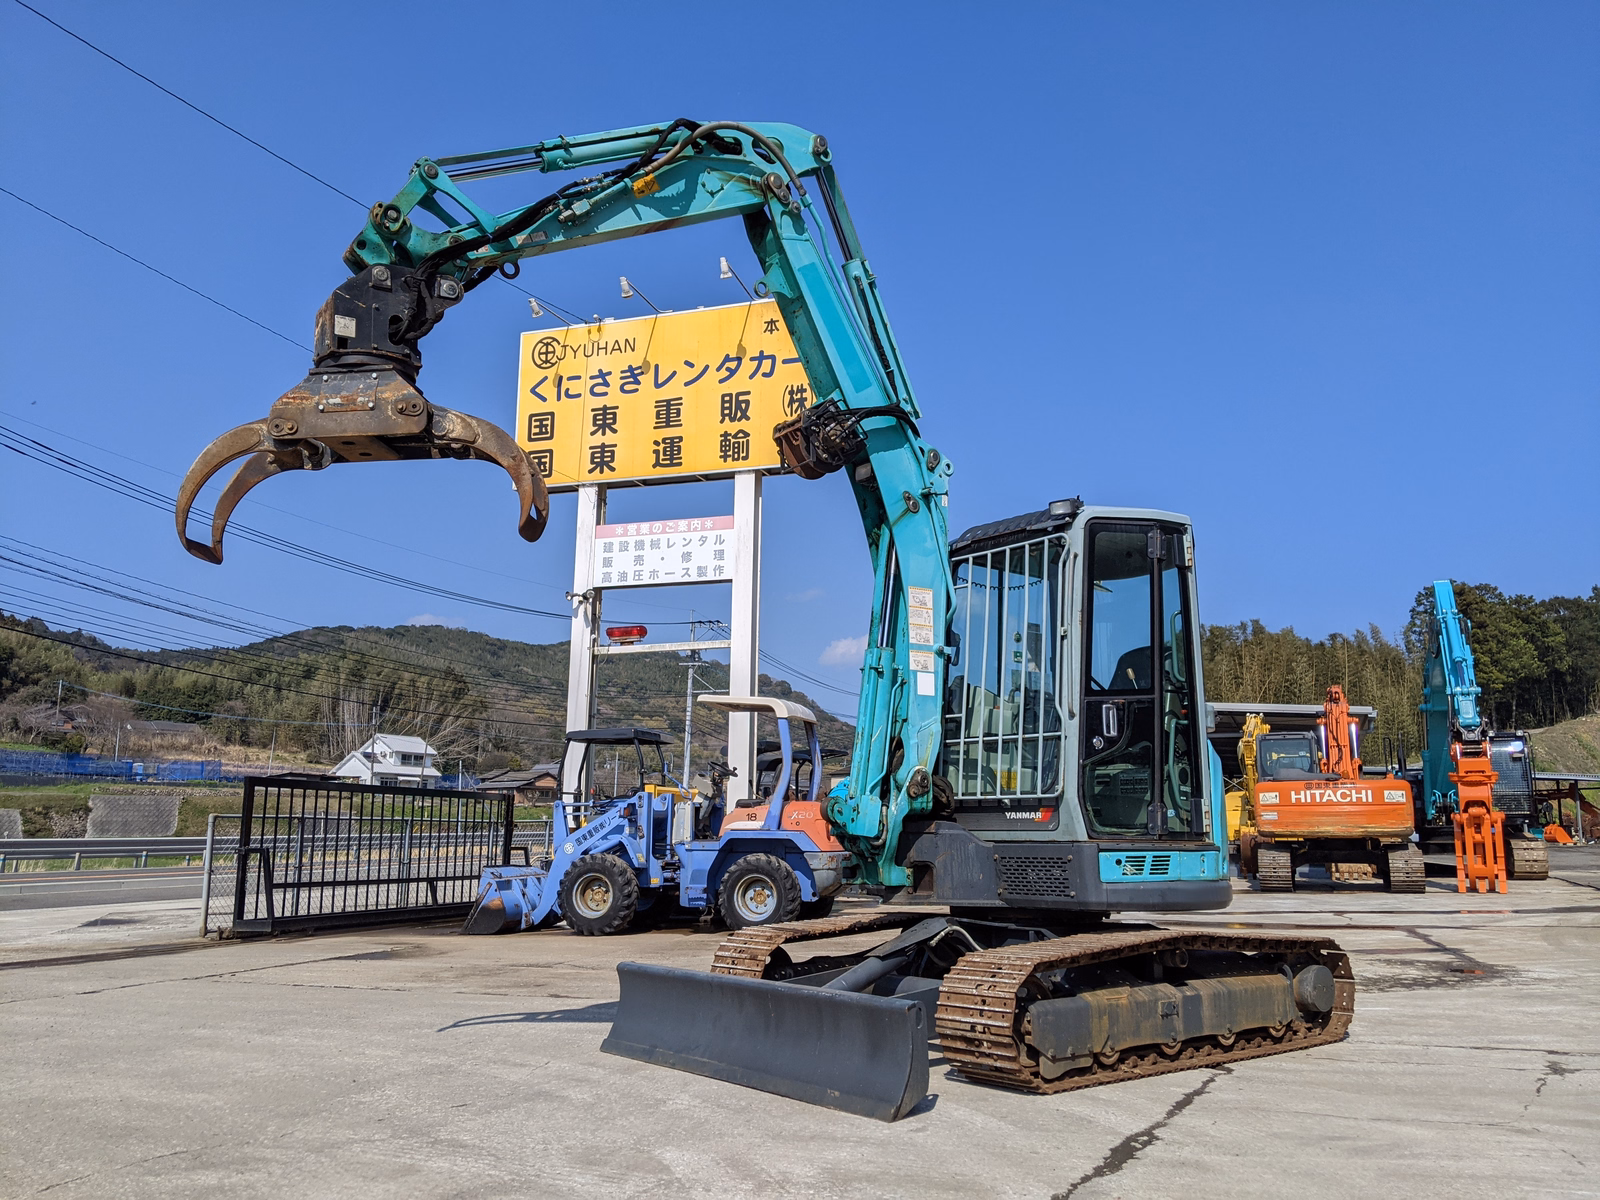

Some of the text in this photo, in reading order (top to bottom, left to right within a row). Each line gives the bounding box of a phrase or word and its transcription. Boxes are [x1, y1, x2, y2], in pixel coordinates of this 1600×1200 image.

[529, 350, 802, 403] くにさきレンタカー
[602, 533, 726, 554] 建設機械レンタル
[601, 564, 725, 584] 高油圧ホース製作
[1290, 789, 1373, 804] HITACHI
[745, 812, 758, 822] 18
[1004, 811, 1042, 820] YANMAR
